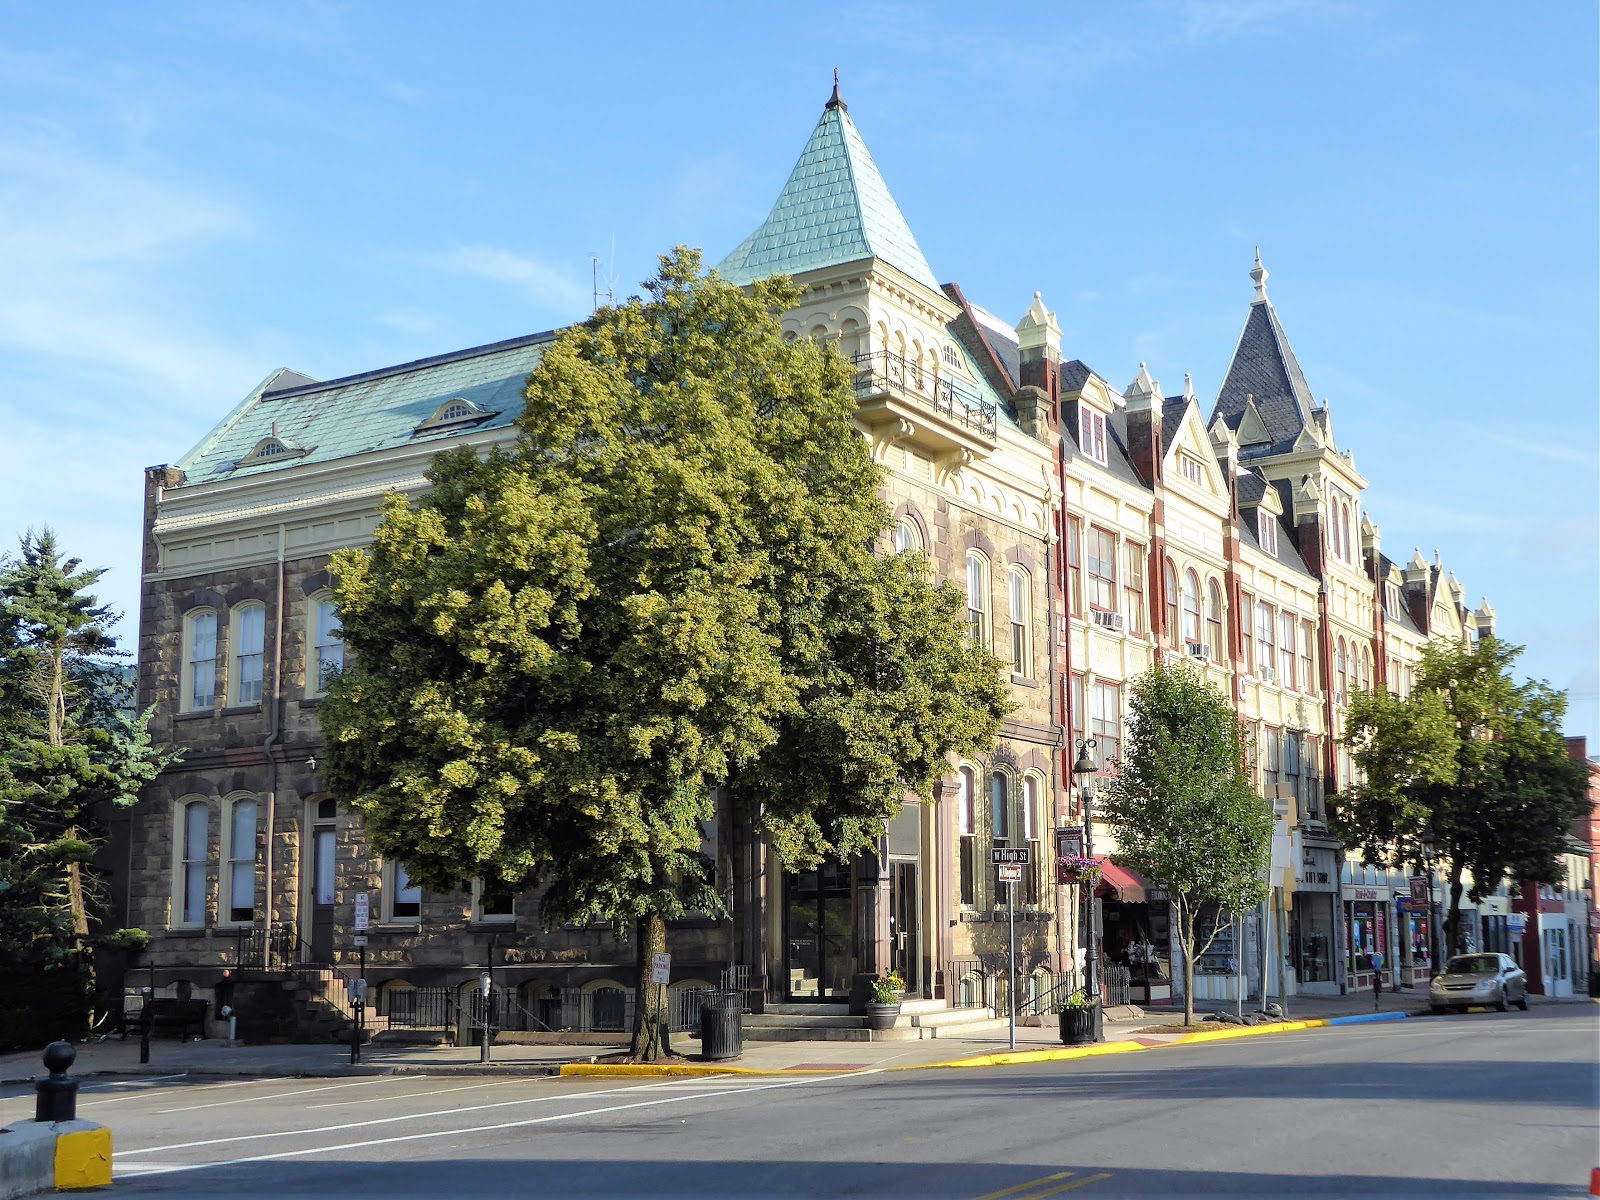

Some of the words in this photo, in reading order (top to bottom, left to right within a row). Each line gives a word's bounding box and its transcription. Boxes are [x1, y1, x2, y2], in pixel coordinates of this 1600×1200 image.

[994, 851, 1000, 861] W
[1001, 849, 1018, 864] High
[1019, 851, 1027, 861] St
